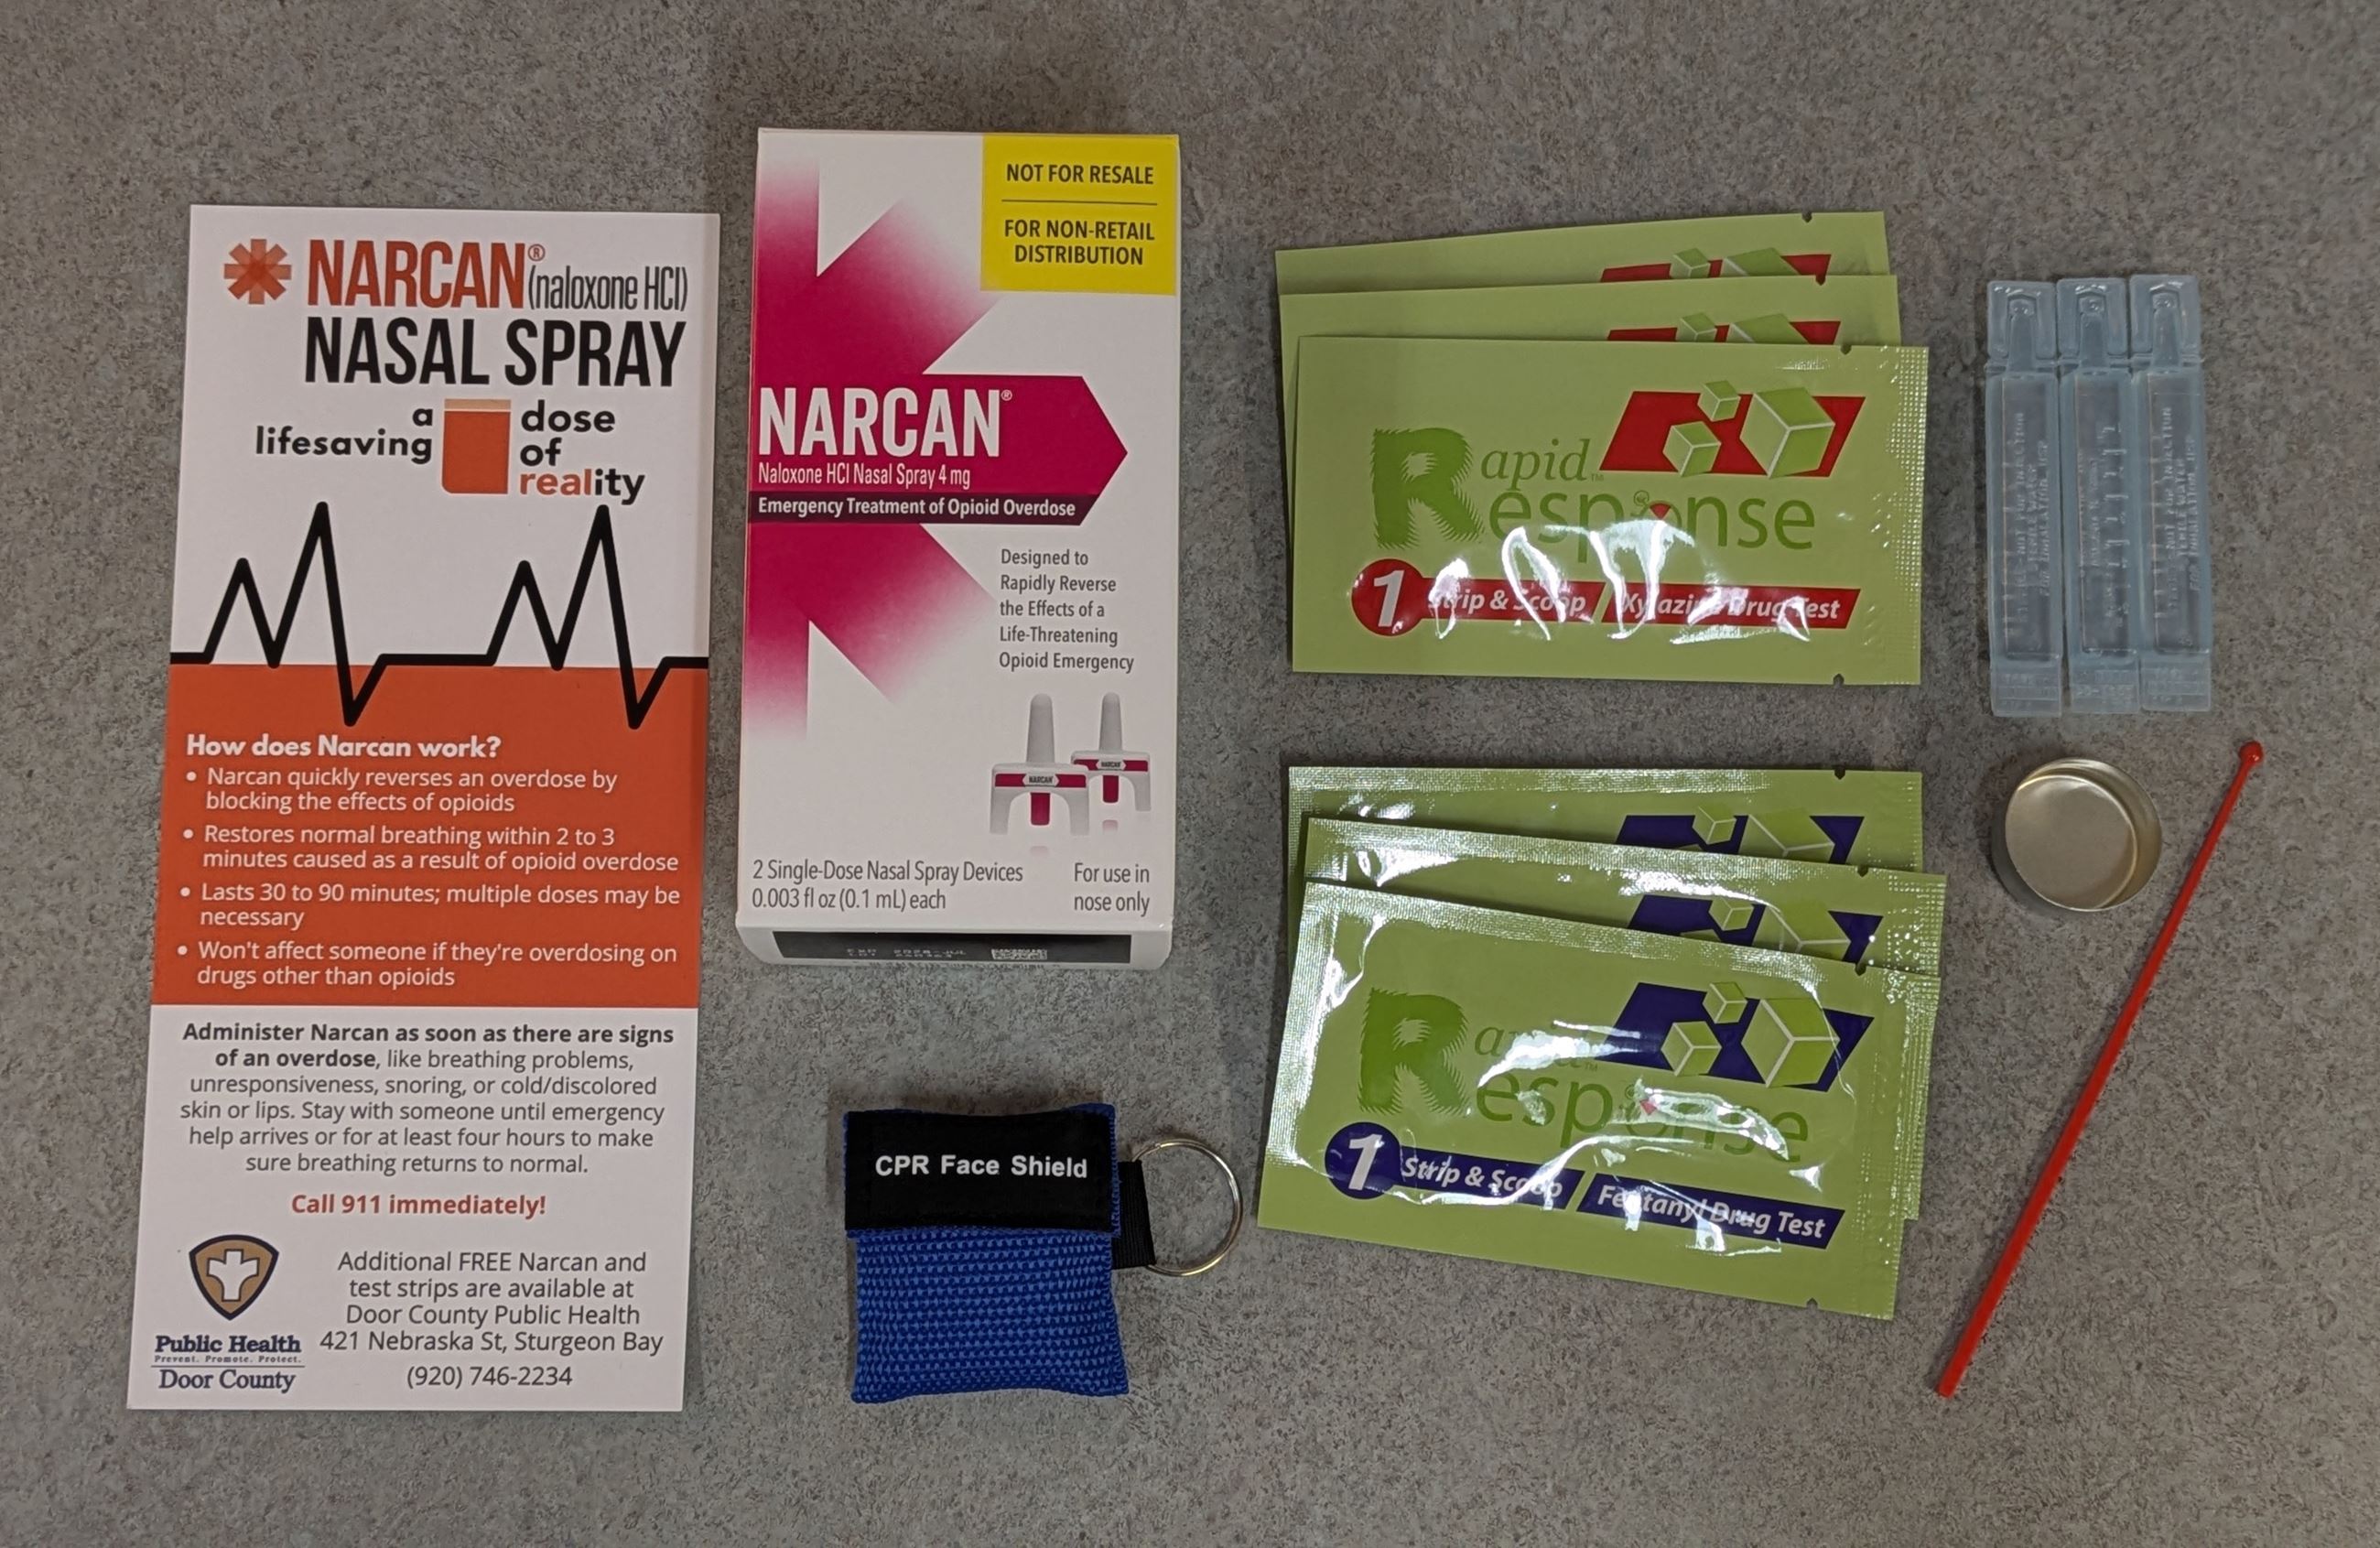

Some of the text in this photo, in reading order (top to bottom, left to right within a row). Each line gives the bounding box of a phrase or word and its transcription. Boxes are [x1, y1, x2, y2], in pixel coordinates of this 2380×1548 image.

[1006, 163, 1154, 185] NOT FOR RESALE
[1004, 219, 1155, 241] FOR NON-RETAIL
[1014, 244, 1143, 265] DISTRIBUTION
[527, 265, 639, 311] (naloxone
[303, 316, 687, 387] NASAL SPRAY
[412, 406, 434, 428] a
[520, 399, 616, 432] dose
[254, 426, 433, 465] lifesaving
[519, 437, 561, 467] of
[519, 469, 646, 506] reality
[758, 461, 823, 484] Naloxone
[853, 462, 892, 485] Nasal
[895, 462, 936, 490] Spray
[938, 463, 947, 485] 4
[950, 469, 970, 491] mg
[758, 496, 1076, 519] Emergency Treatment of Opioid Overdose
[1001, 548, 1089, 569] Designed to
[1001, 573, 1117, 595] Rapidly Reverse
[1000, 599, 1105, 618] the Effects of a
[1374, 569, 1405, 628] 1
[1489, 589, 1509, 611] &
[1000, 624, 1118, 648] Life-Threatening
[999, 651, 1135, 675] Opioid Emergency
[187, 732, 502, 758] How does Narcan work?
[207, 766, 618, 794] Narcan quickly reverses an overdose by
[206, 790, 515, 817] blocking the effects of opioids
[752, 858, 1023, 887] 2 Single-Dose Nasal Spray Devices
[1074, 861, 1150, 883] For use in
[752, 886, 947, 913] 0.003 fl oz (0.1 mL) each
[1074, 890, 1151, 918] nose only
[200, 911, 305, 931] necessary
[182, 1022, 674, 1048] Administer Narcan as soon as there are signs
[215, 1048, 633, 1074] of an overdose, like breathing problems,
[874, 1153, 1088, 1179] CPR Face Shield
[1347, 1133, 1383, 1191] 1
[1401, 1156, 1461, 1187] Strip
[1465, 1165, 1485, 1187] &
[291, 1193, 546, 1220] Call 911 immediately!
[1777, 1210, 1826, 1239] Test
[337, 1250, 646, 1272] Additional FREE Narcan and
[349, 1277, 634, 1304] test strips are available at
[346, 1304, 640, 1330] Door County Public Health
[154, 1334, 302, 1353] Public Health
[319, 1329, 664, 1358] 421 Nebraska St, Sturgeon Bay
[154, 1355, 200, 1363] Prevent.
[204, 1355, 254, 1363] Promote.
[157, 1369, 297, 1394] Door County
[406, 1366, 573, 1390] (920) 746-2234
